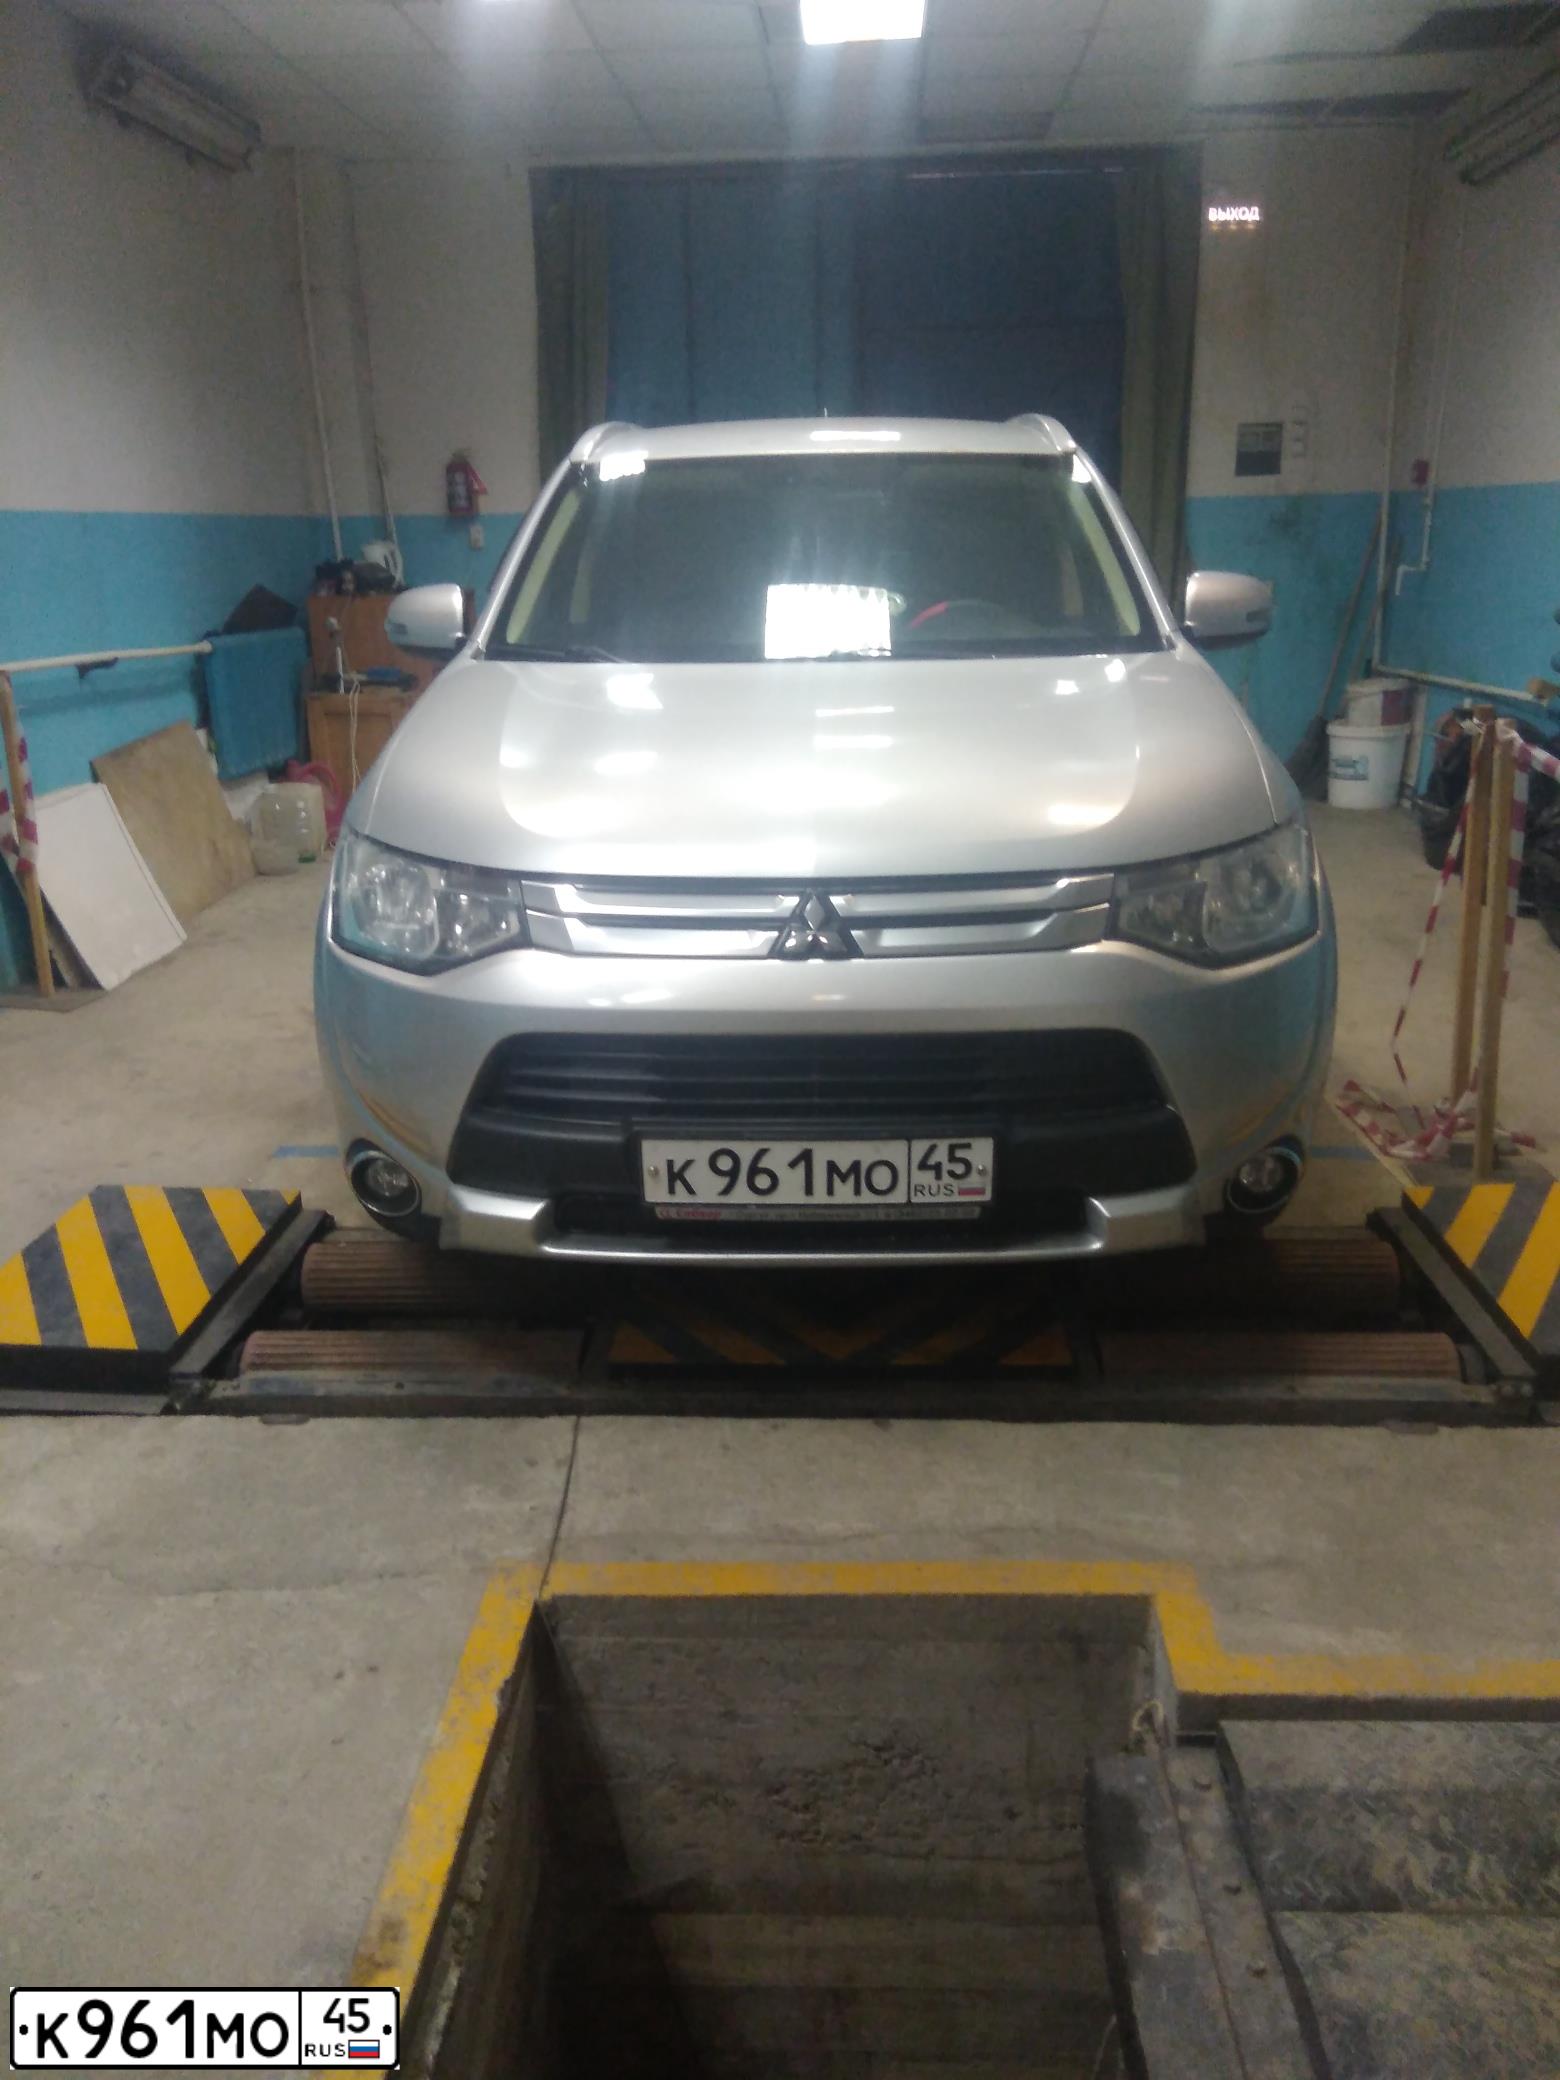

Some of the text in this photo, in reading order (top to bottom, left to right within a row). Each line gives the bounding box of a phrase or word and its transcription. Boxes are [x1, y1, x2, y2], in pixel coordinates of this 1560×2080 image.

[1208, 206, 1260, 221] ВЫХОД
[917, 1143, 973, 1181] 45
[914, 1183, 954, 1197] RUS
